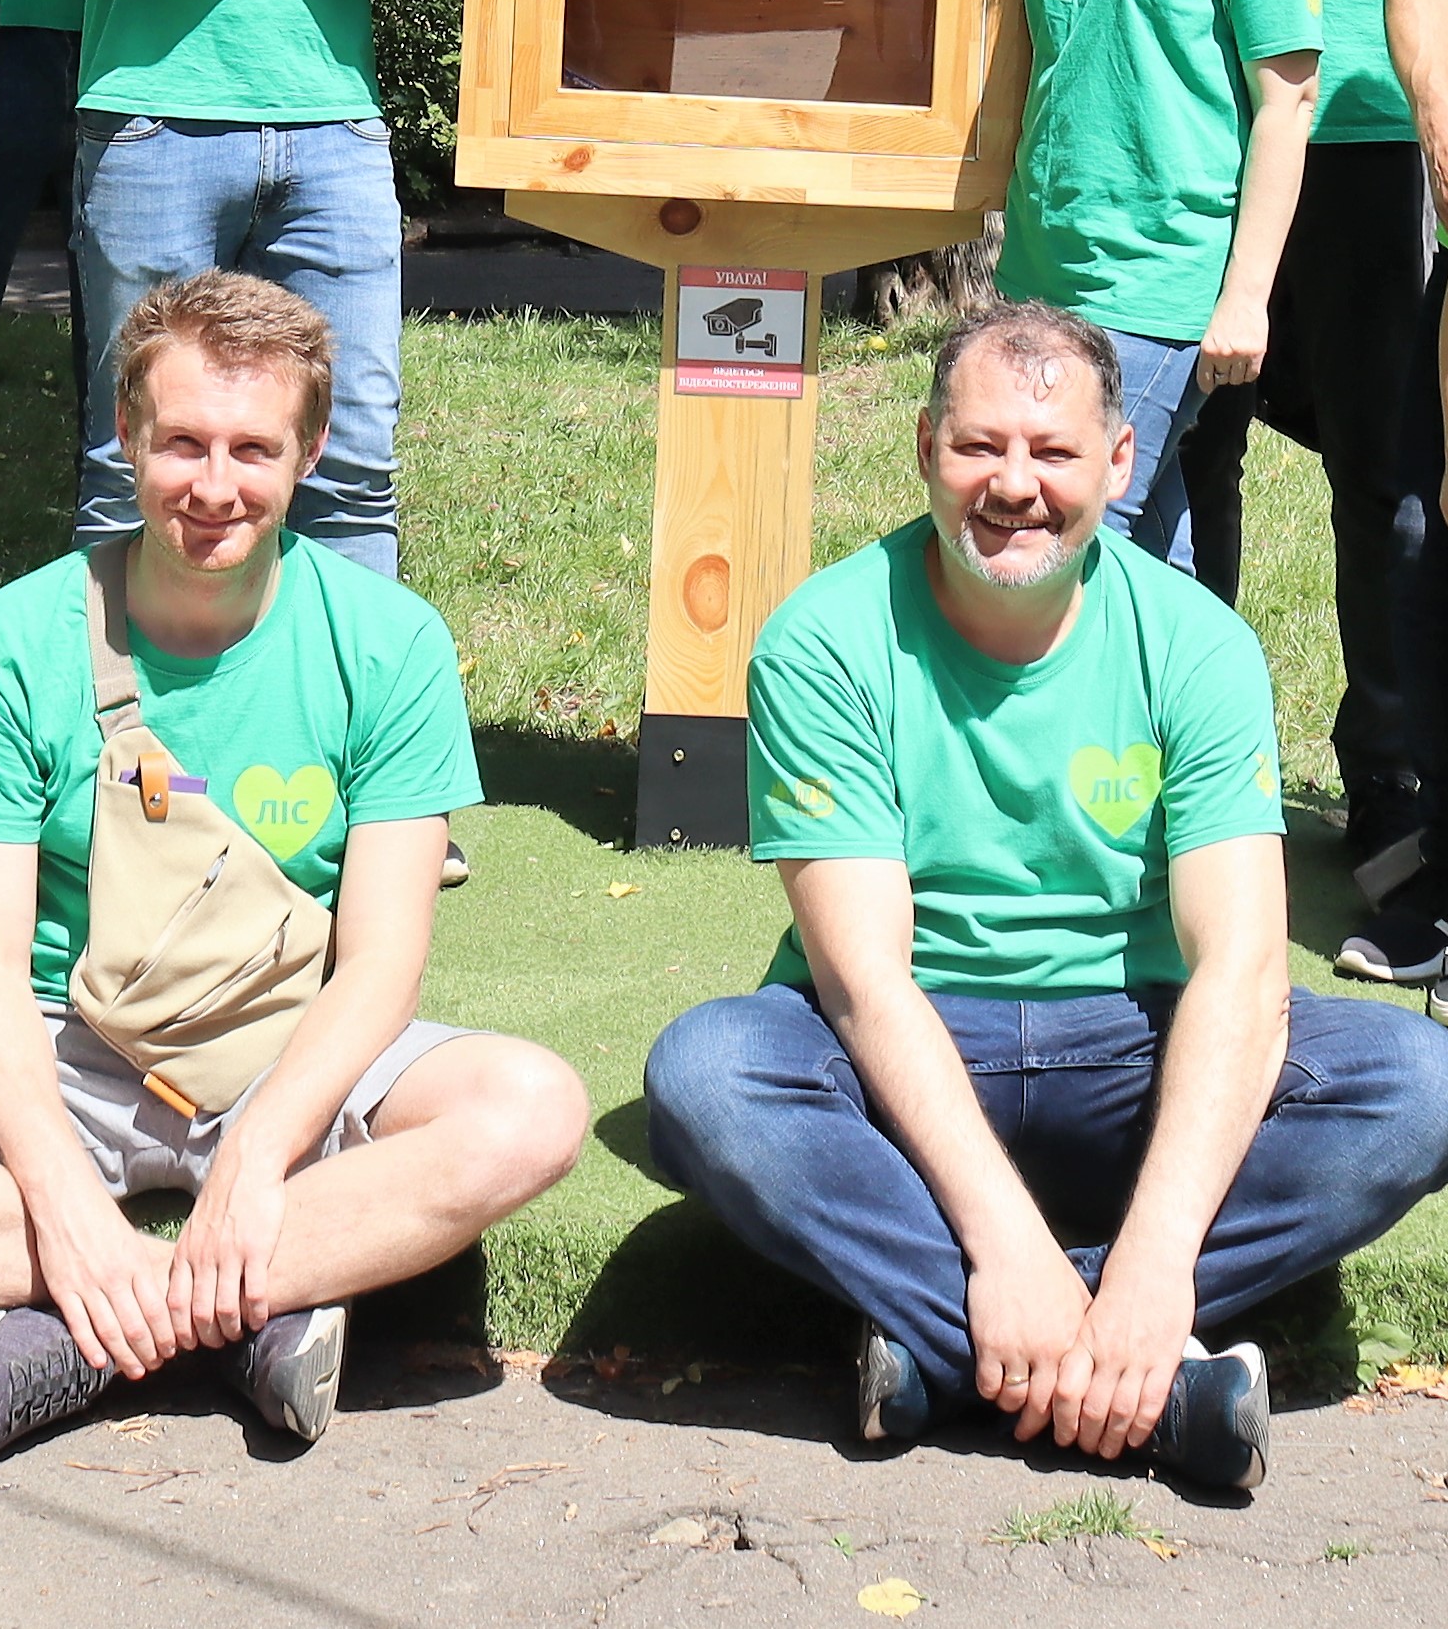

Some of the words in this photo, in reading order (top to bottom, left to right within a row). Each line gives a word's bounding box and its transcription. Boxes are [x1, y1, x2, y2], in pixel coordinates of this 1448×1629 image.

[716, 271, 767, 286] УВАГА!
[1088, 776, 1139, 804] ЛІС
[256, 799, 308, 825] ЛІС
